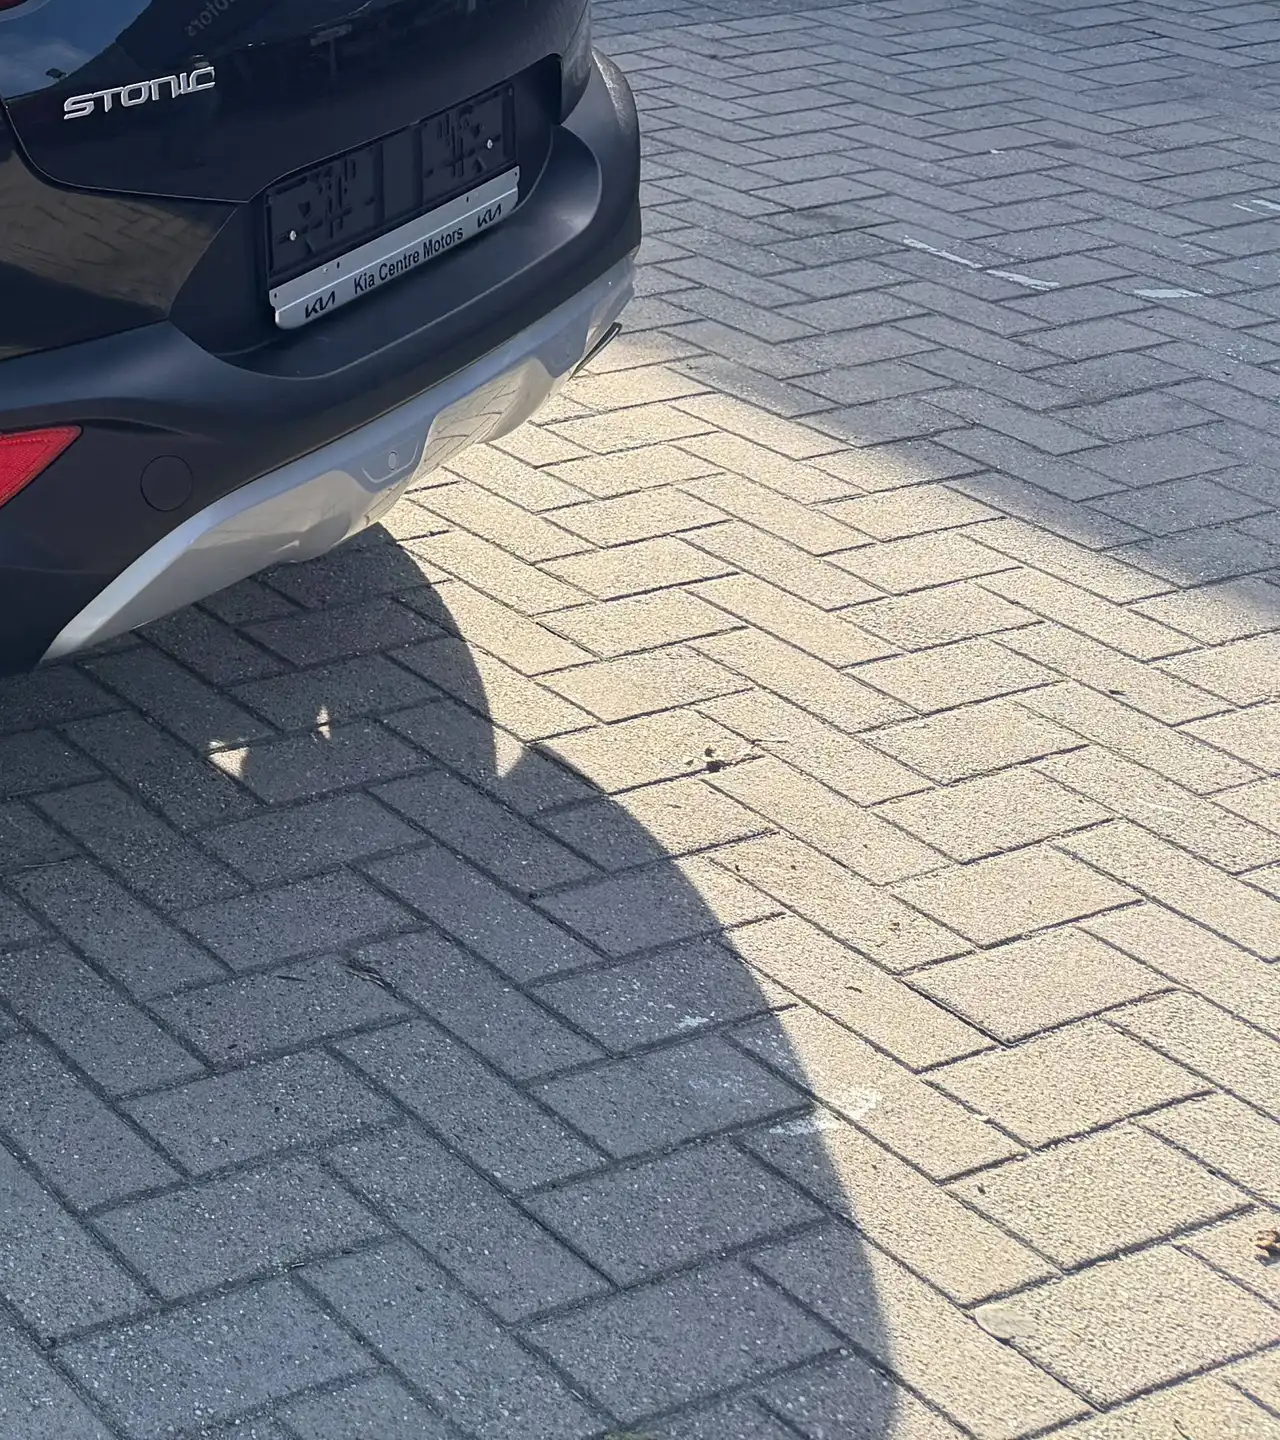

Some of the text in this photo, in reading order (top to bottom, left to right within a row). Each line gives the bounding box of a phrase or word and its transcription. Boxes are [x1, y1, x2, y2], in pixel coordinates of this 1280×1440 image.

[63, 65, 216, 120] STONIC
[304, 203, 502, 320] KIA Kia Centre Motors KIA
